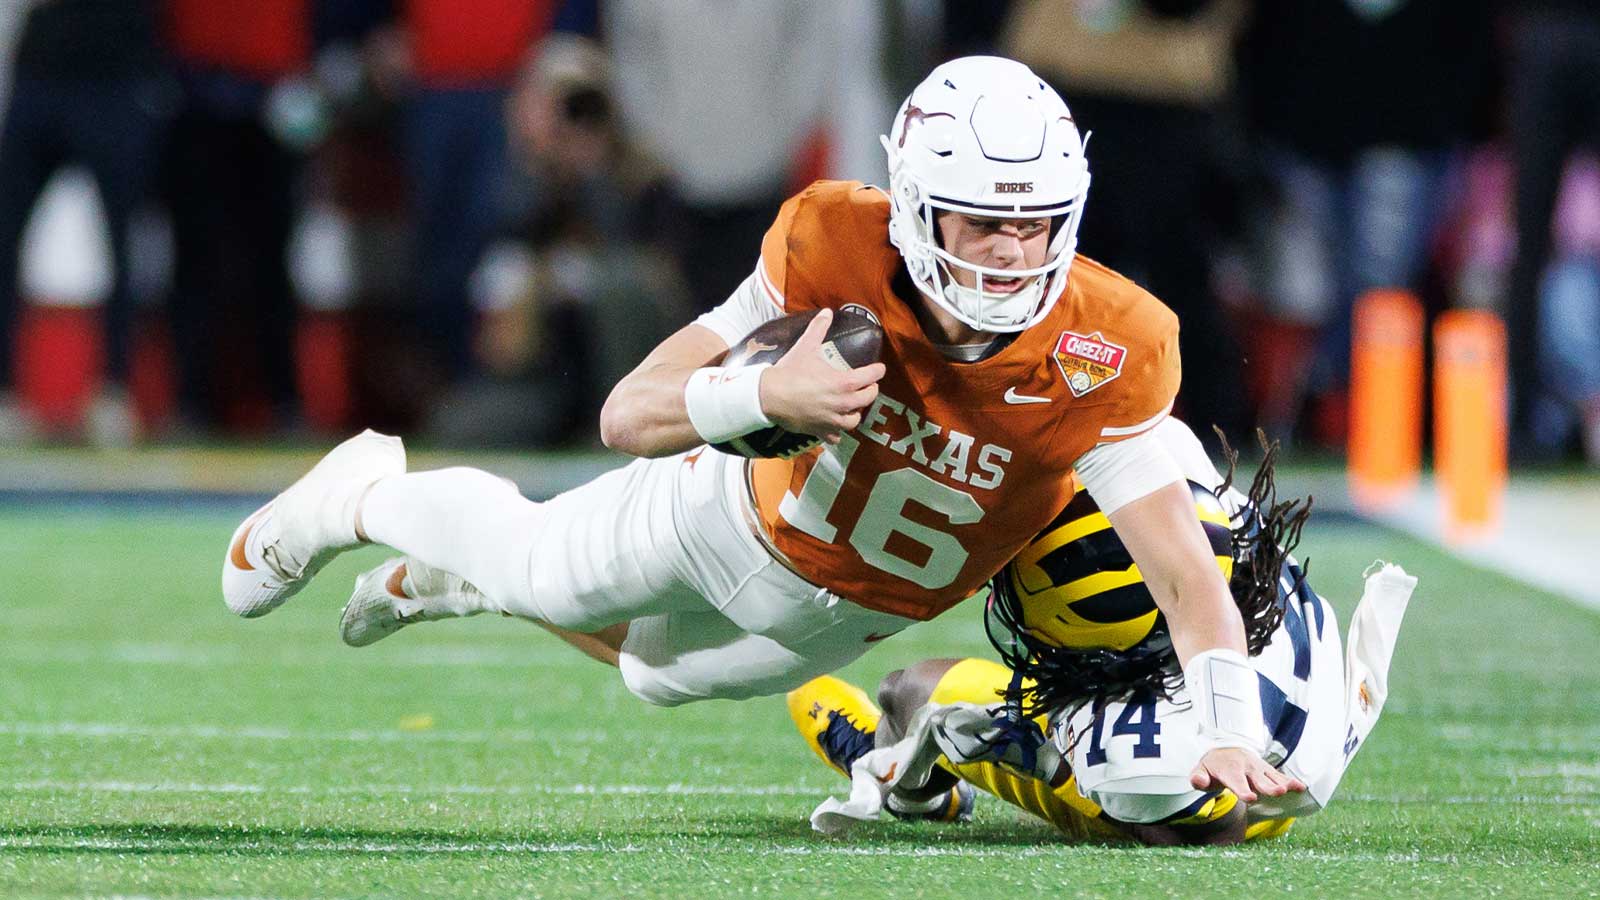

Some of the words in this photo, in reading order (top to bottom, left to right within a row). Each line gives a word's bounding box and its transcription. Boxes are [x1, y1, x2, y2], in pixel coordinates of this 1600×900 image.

[994, 182, 1034, 194] HORNS
[857, 393, 1013, 490] EXAS
[778, 430, 986, 590] 16
[1086, 694, 1161, 767] 14
